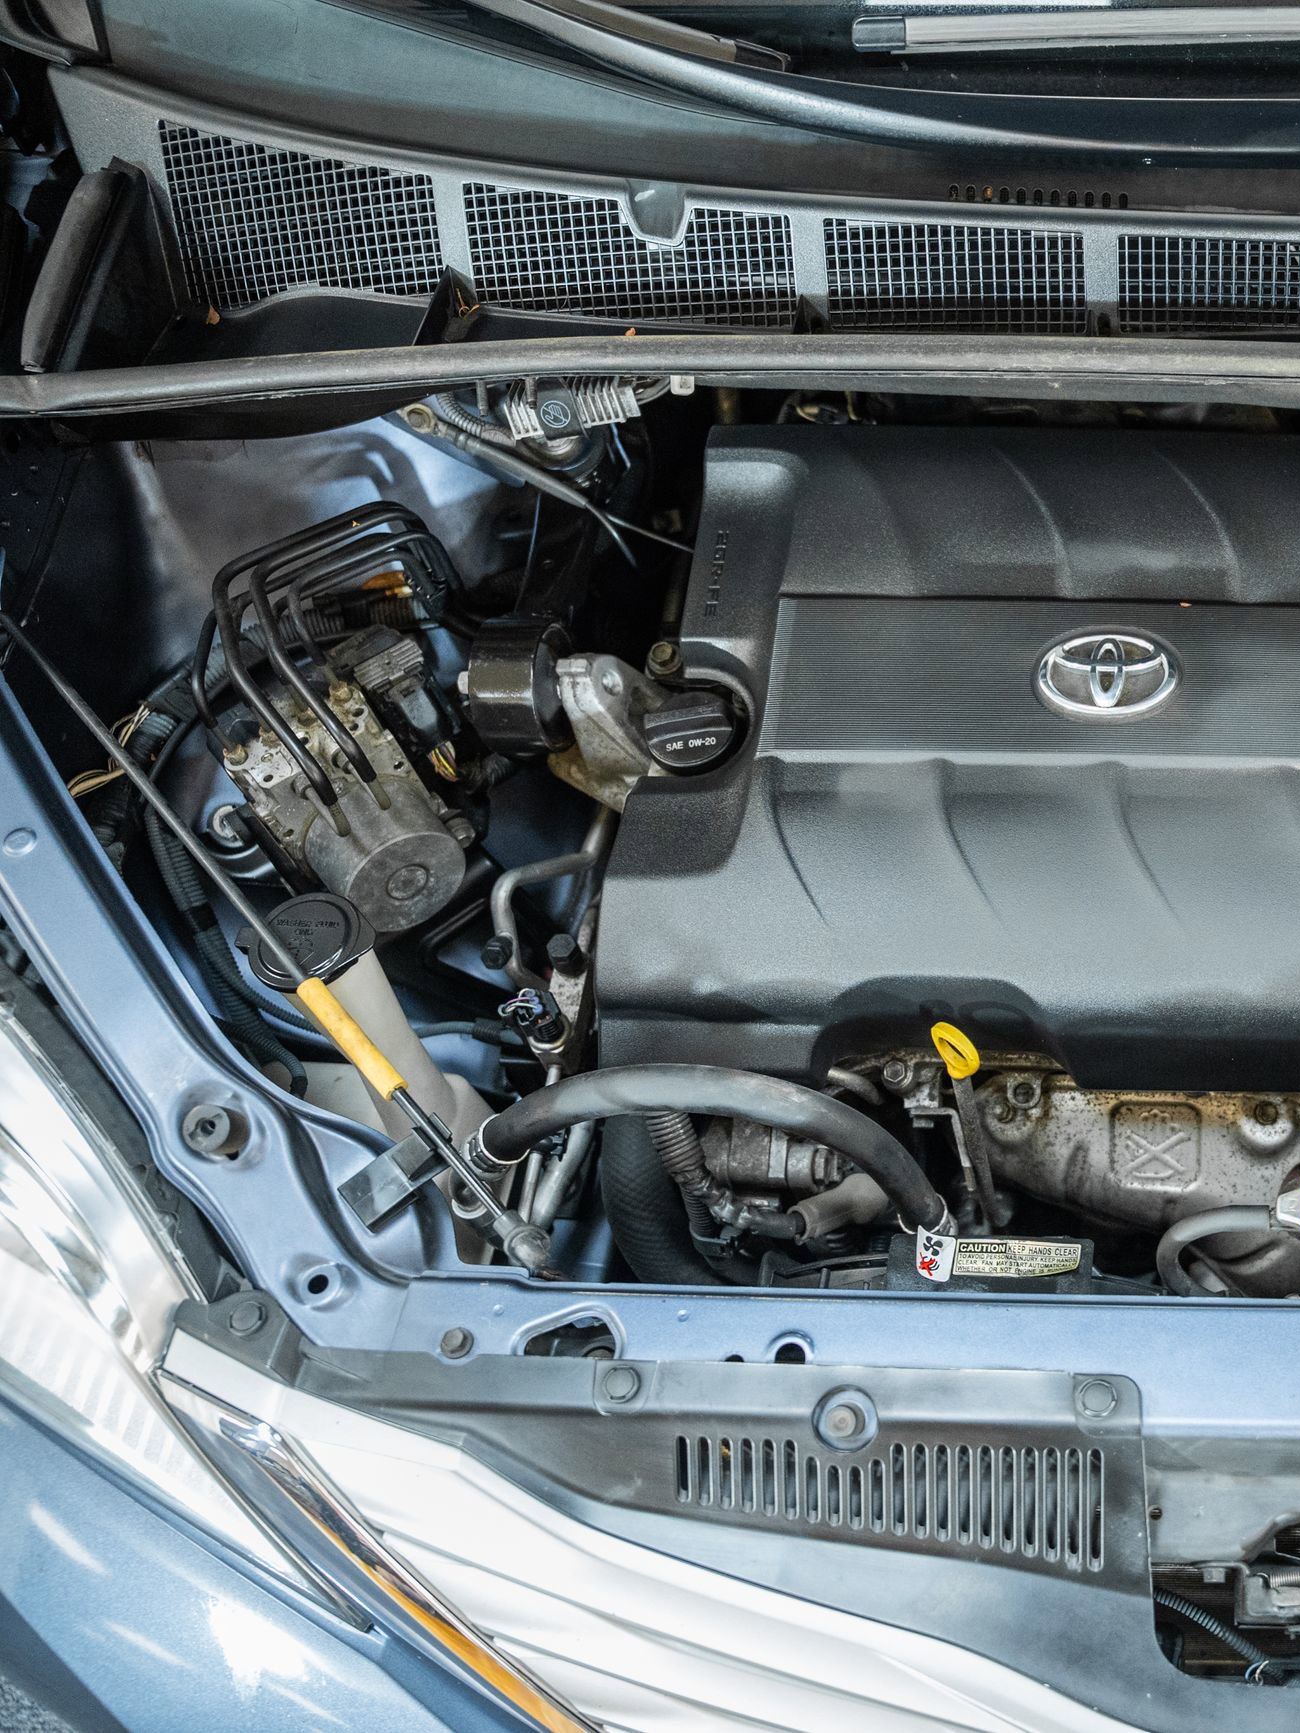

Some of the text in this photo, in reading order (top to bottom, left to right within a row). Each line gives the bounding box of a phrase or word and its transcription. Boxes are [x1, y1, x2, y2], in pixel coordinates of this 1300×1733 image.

[704, 529, 730, 617] 2GR-FE
[666, 737, 717, 752] SAE 0W-20
[960, 1244, 1078, 1257] CAUTION KEEP HANDS CLEAR
